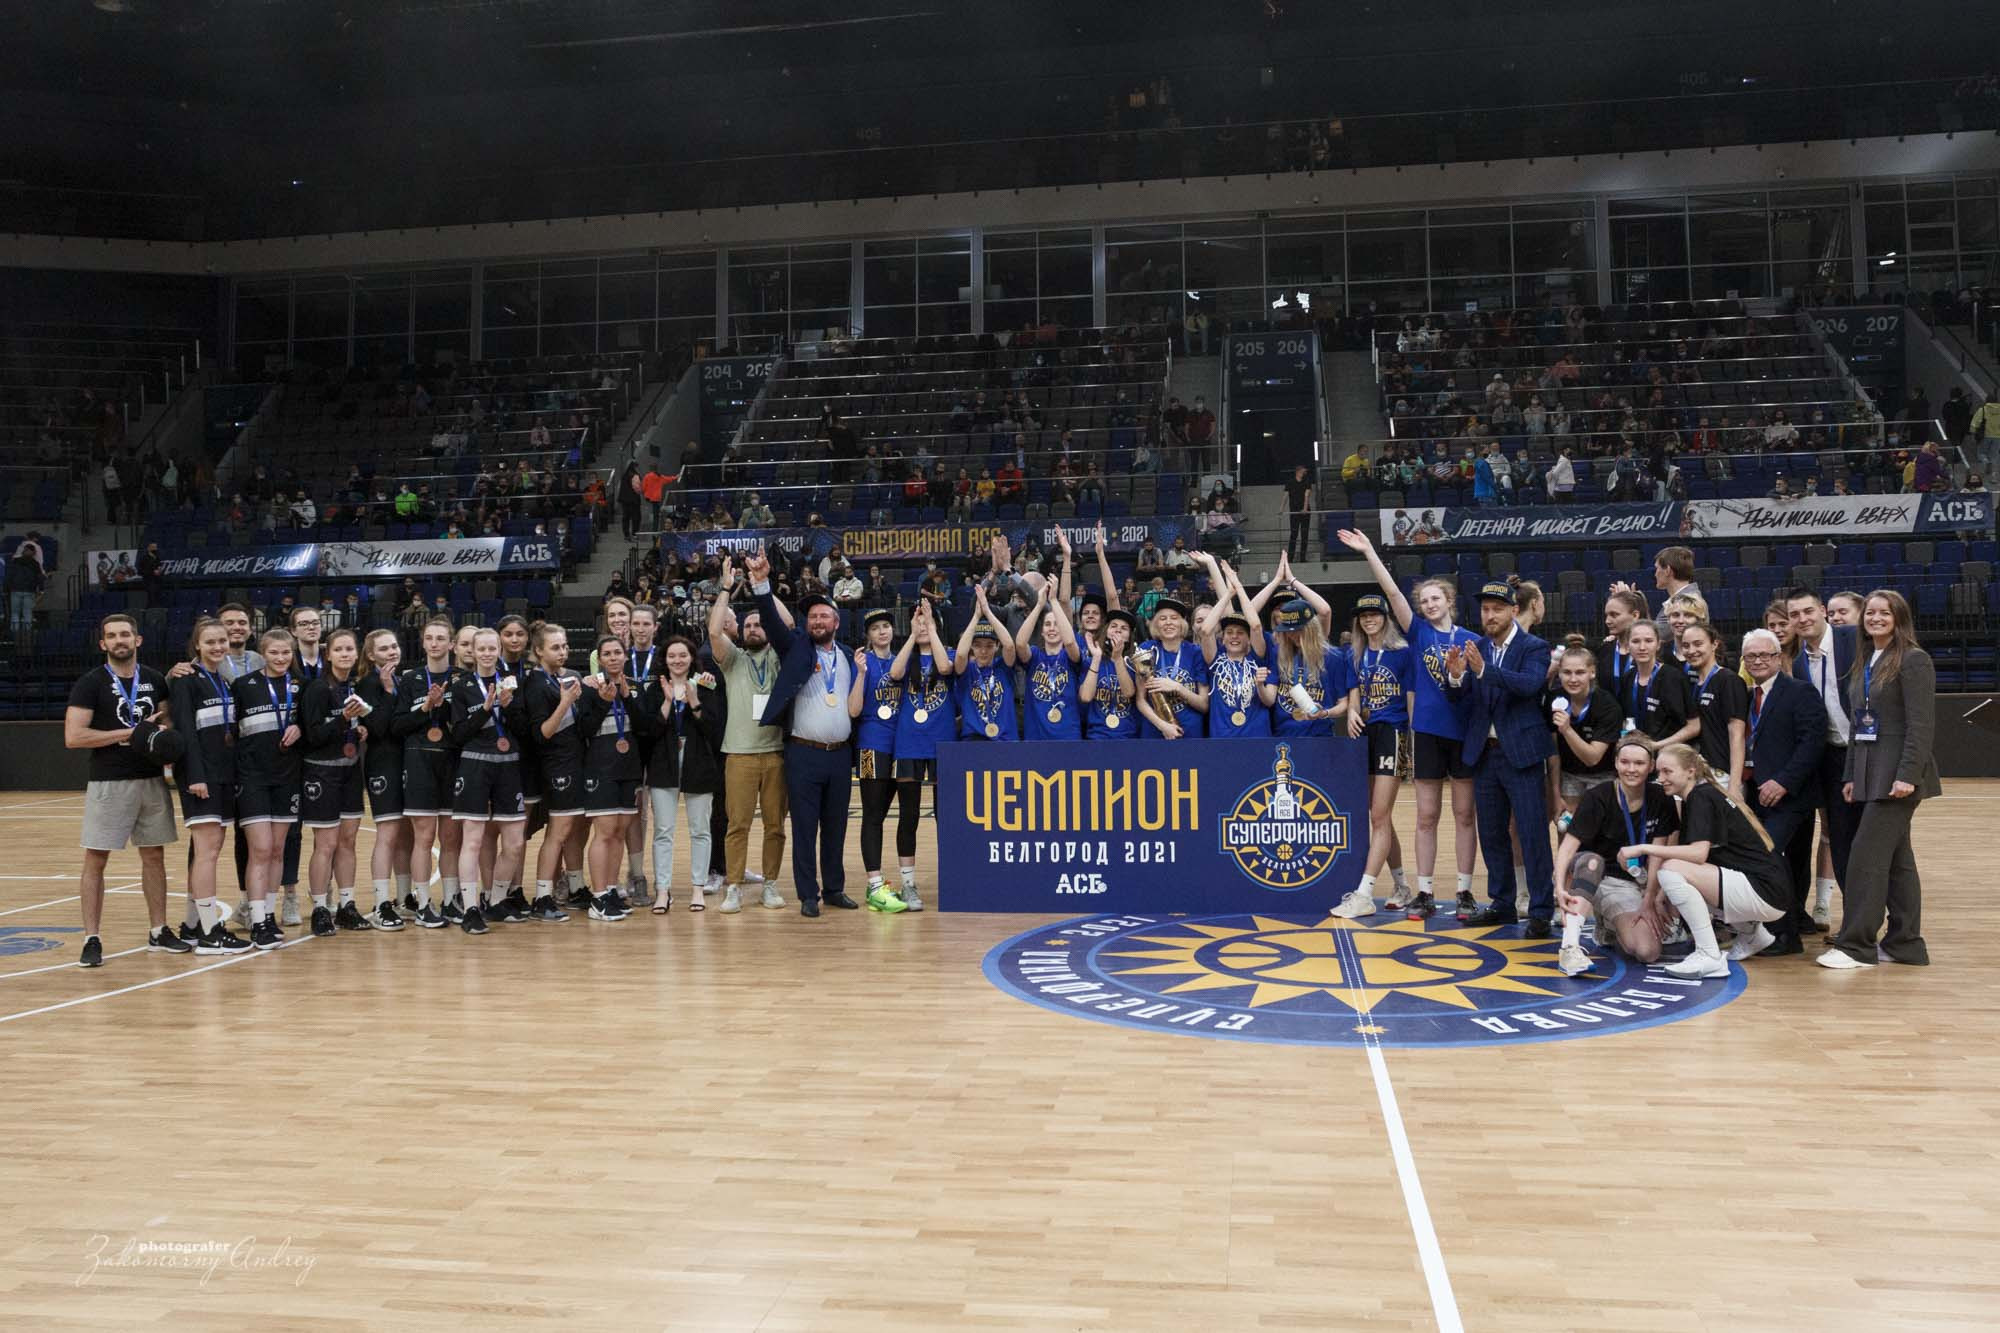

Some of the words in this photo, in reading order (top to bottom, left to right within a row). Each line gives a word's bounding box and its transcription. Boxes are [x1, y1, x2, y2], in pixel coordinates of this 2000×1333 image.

[1866, 316, 1898, 332] 207
[1235, 341, 1264, 356] 205
[1277, 339, 1306, 355] 206
[704, 364, 732, 379] 204
[746, 362, 773, 377] 205
[1928, 501, 1984, 522] АСБ
[843, 528, 962, 556] СУПЕРФИНАЛ
[1121, 525, 1148, 542] 2021
[510, 543, 552, 563] АСБ
[1379, 755, 1394, 769] 14
[965, 768, 1199, 831] ЧЕМПИОН
[1228, 822, 1341, 844] СУПЕРФИНАЛ
[989, 841, 1108, 865] БЕЛГОРОД
[1125, 841, 1176, 863] 2021
[1261, 856, 1310, 871] БЕЛГОРОД
[1055, 873, 1107, 894] АСБ
[1060, 915, 1156, 937] 2021
[1018, 951, 1254, 1031] СУПЕРФИНАЛ
